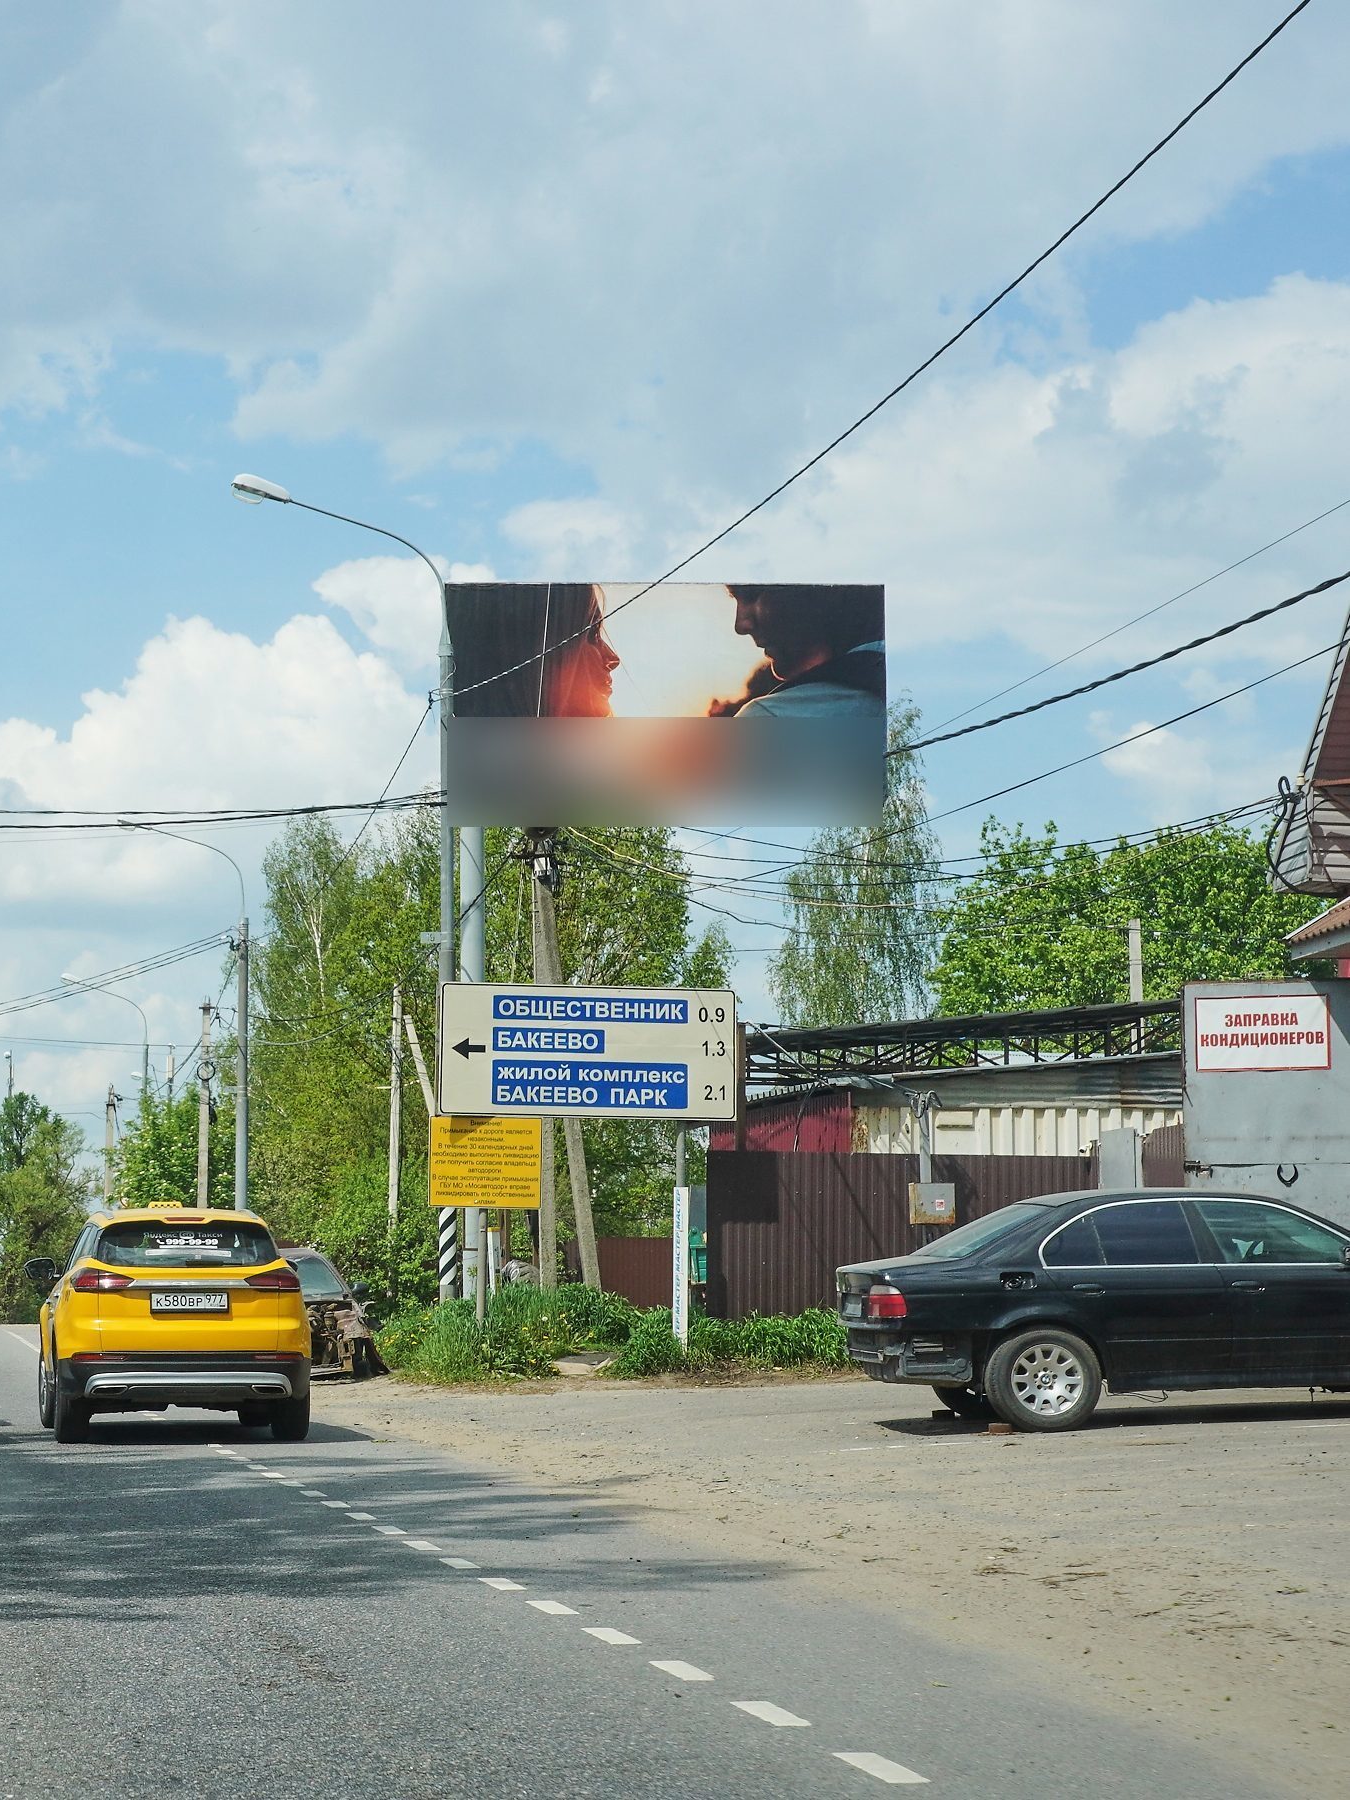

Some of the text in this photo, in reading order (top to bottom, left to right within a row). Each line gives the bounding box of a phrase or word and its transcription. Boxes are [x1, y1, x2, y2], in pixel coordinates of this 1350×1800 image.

[498, 999, 684, 1021] ОБЩЕСТВЕННИК
[698, 1006, 725, 1023] 0.9
[1224, 1012, 1299, 1028] ЗАПРАВКА
[497, 1031, 599, 1051] БАКЕЕВО
[1200, 1031, 1325, 1049] КОНДИЦИОНЕРОВ
[701, 1041, 726, 1057] 1.3
[496, 1085, 668, 1106] БАКЕЕВО ПАРК
[703, 1084, 727, 1101] 2.1
[156, 1294, 224, 1307] К580ВР 977
